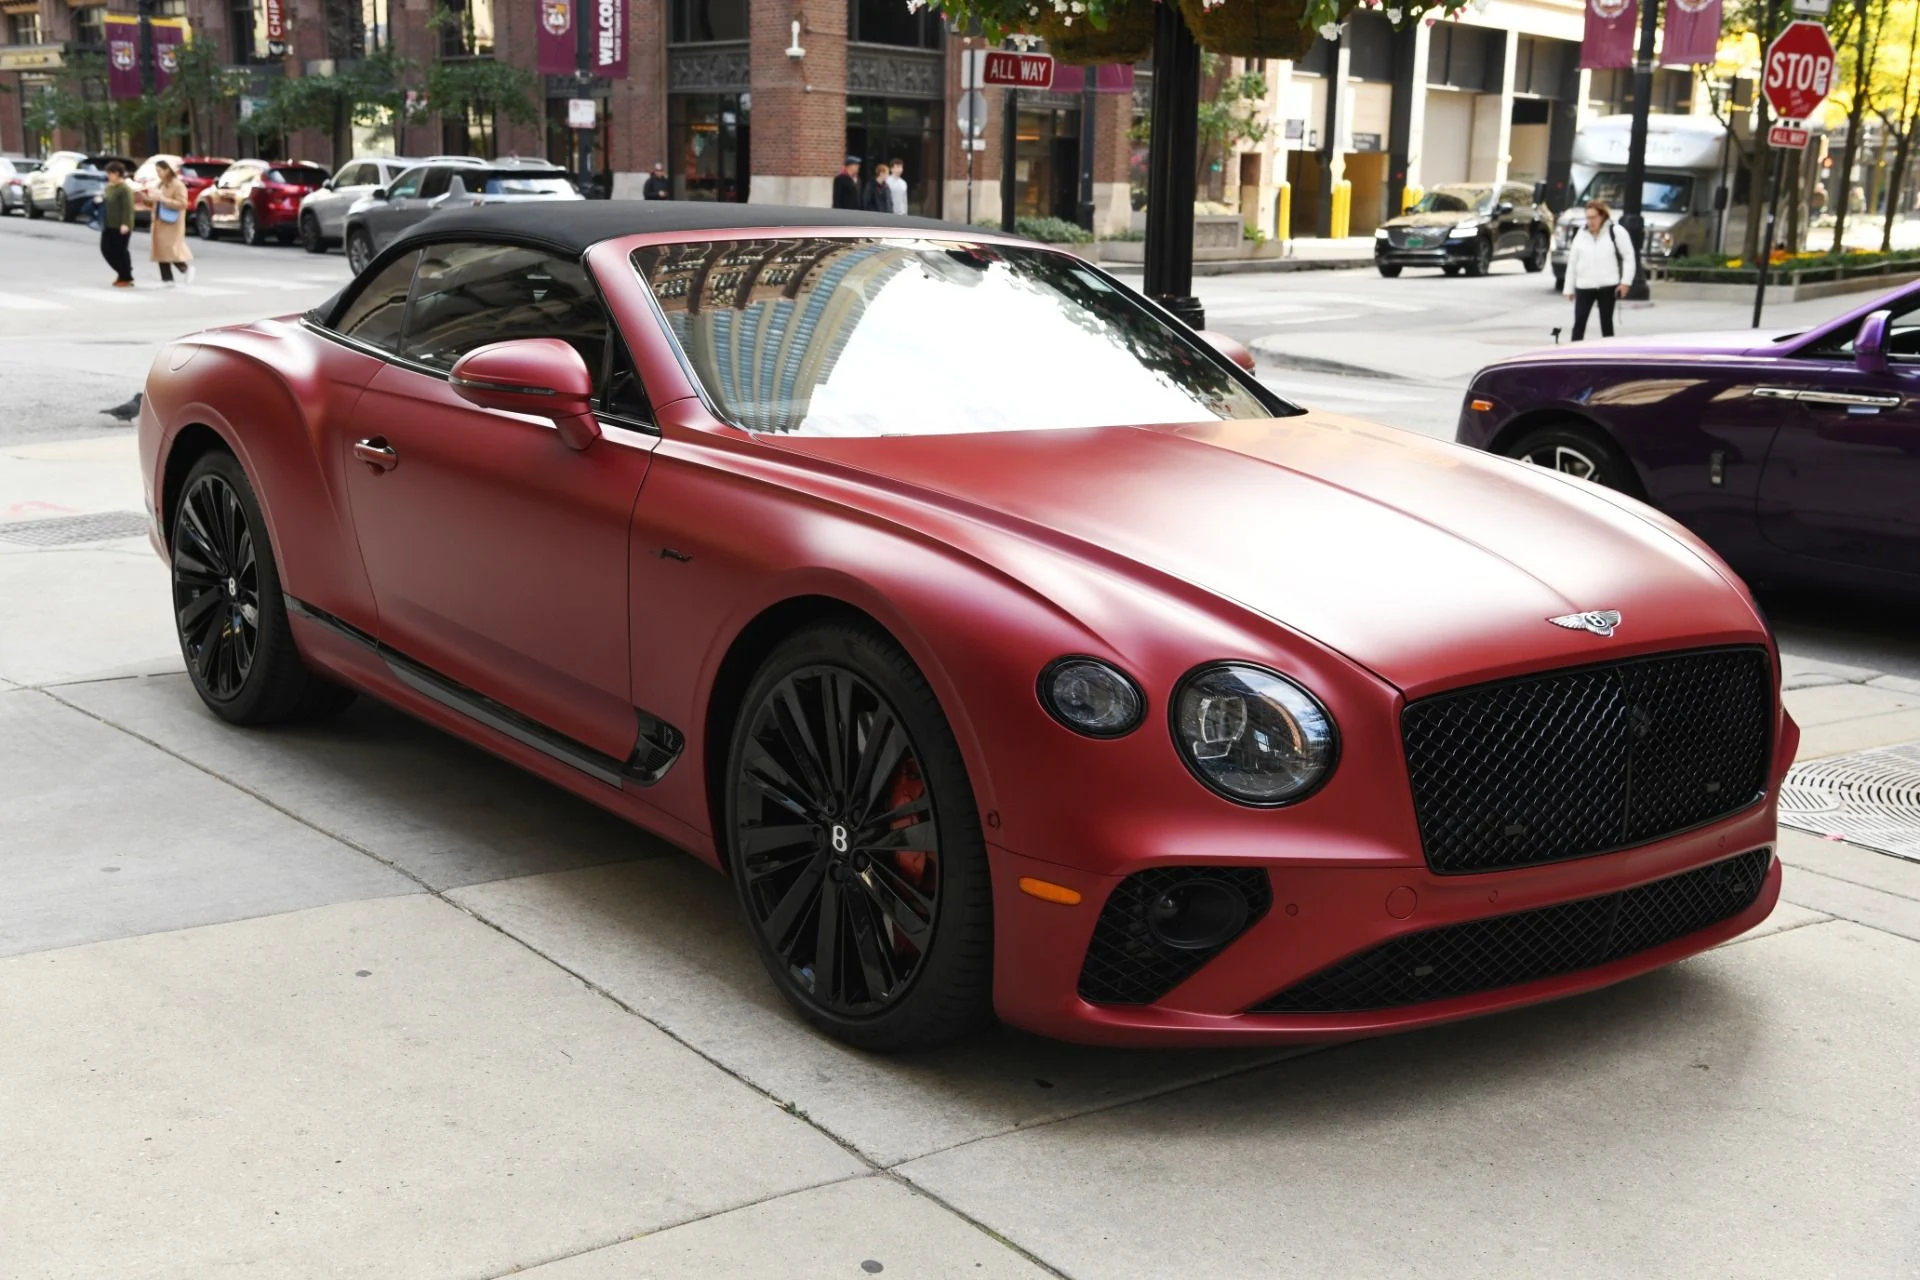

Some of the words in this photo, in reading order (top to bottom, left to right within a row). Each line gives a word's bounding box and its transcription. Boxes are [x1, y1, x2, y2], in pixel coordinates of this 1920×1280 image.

[598, 0, 614, 66] WELCO
[990, 58, 1015, 80] ALL
[1020, 60, 1048, 81] WAY
[1768, 51, 1831, 91] STOP
[832, 825, 848, 853] B
